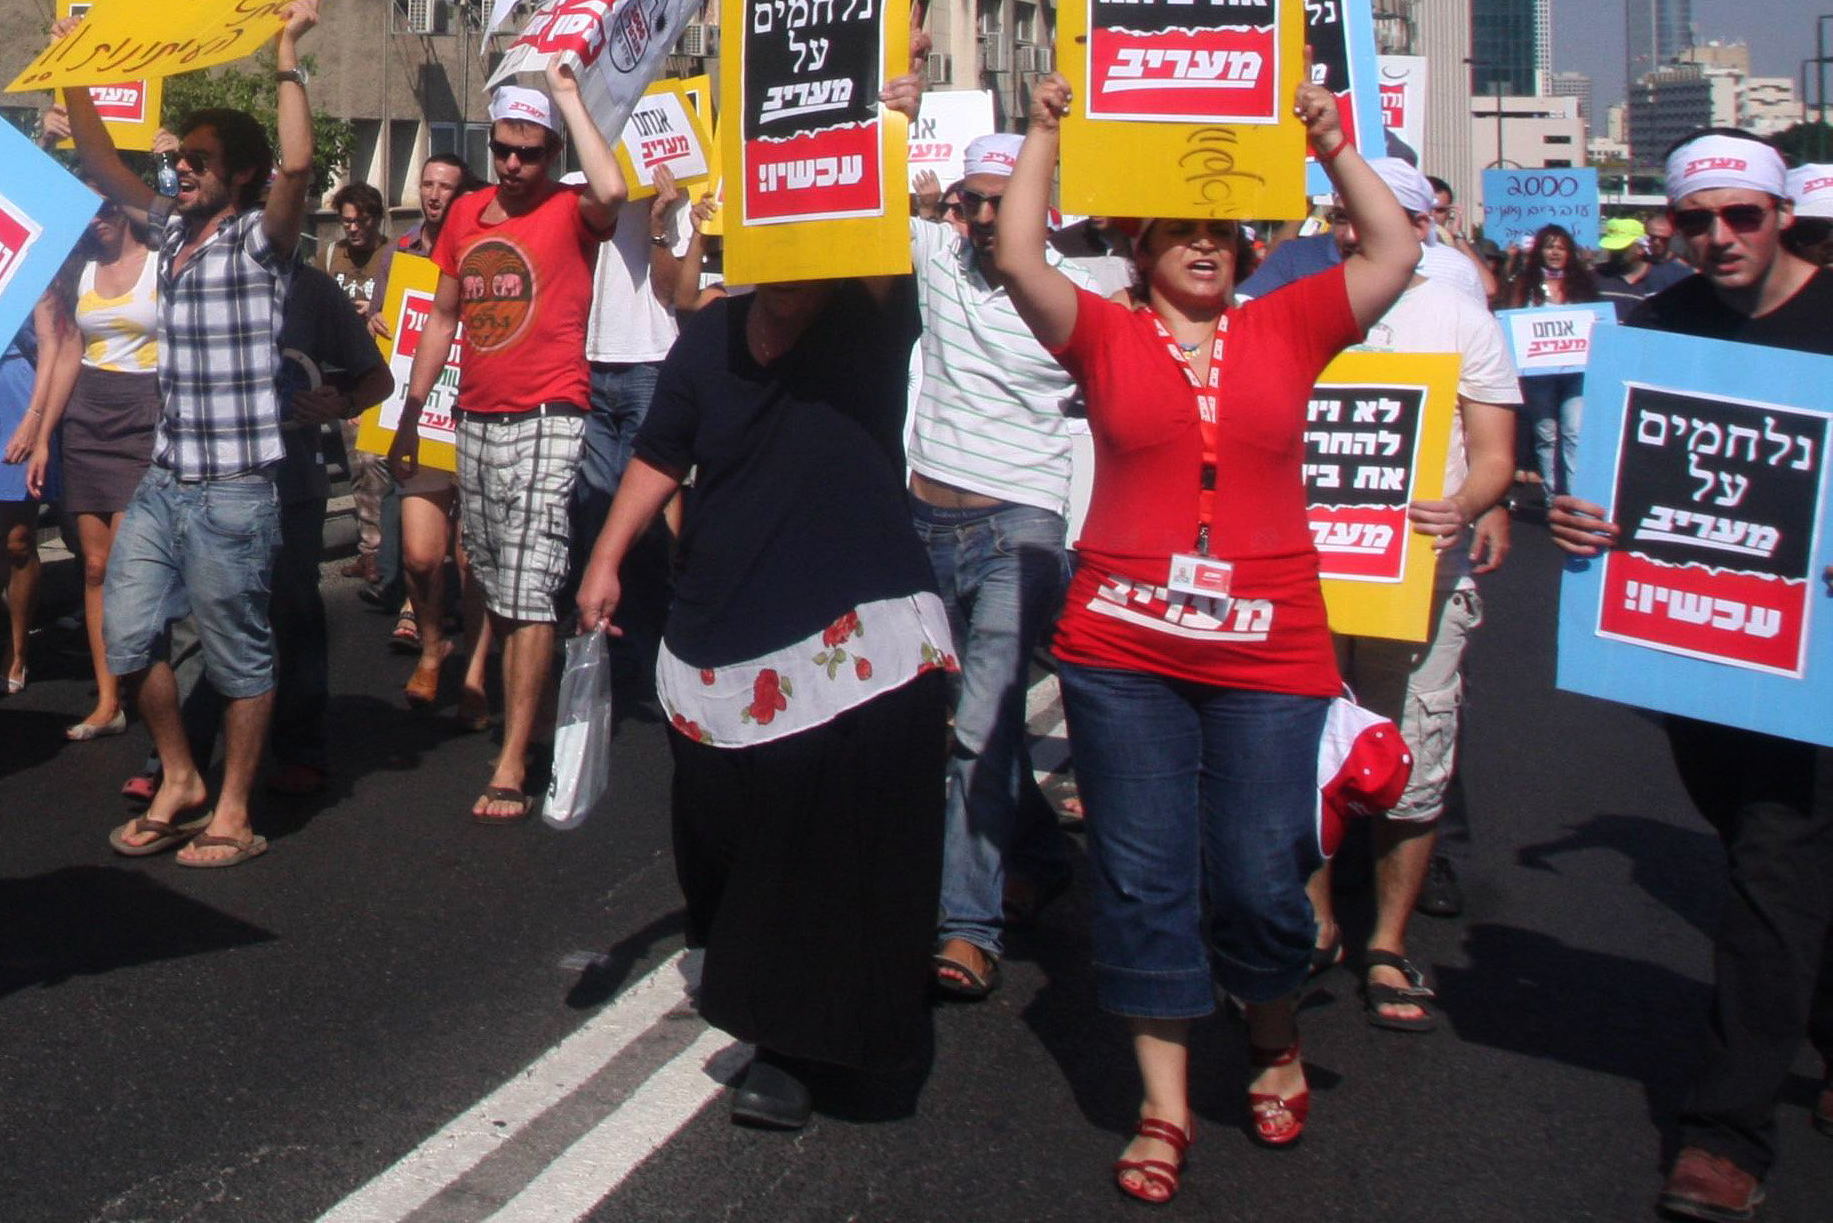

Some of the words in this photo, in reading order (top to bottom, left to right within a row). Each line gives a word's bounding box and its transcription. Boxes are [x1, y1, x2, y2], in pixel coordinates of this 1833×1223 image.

[788, 29, 829, 74] על
[1107, 48, 1263, 81] מעריב
[88, 87, 138, 107] מערי
[761, 77, 853, 112] מעריב
[630, 107, 674, 137] אנחנו
[640, 134, 690, 160] מעריב
[758, 154, 863, 193] עכשיו!
[1684, 157, 1748, 176] מעריב
[1532, 320, 1575, 338] אנחנו
[1528, 338, 1587, 352] מעריב
[1353, 398, 1402, 423] לא
[1303, 430, 1402, 456] להחרי
[1637, 409, 1814, 471] נלחמים
[1353, 465, 1406, 491] את
[1688, 453, 1749, 507] על
[1308, 521, 1394, 548] מער
[1639, 505, 1781, 552] מעריב
[1623, 579, 1782, 639] עכשיו!
